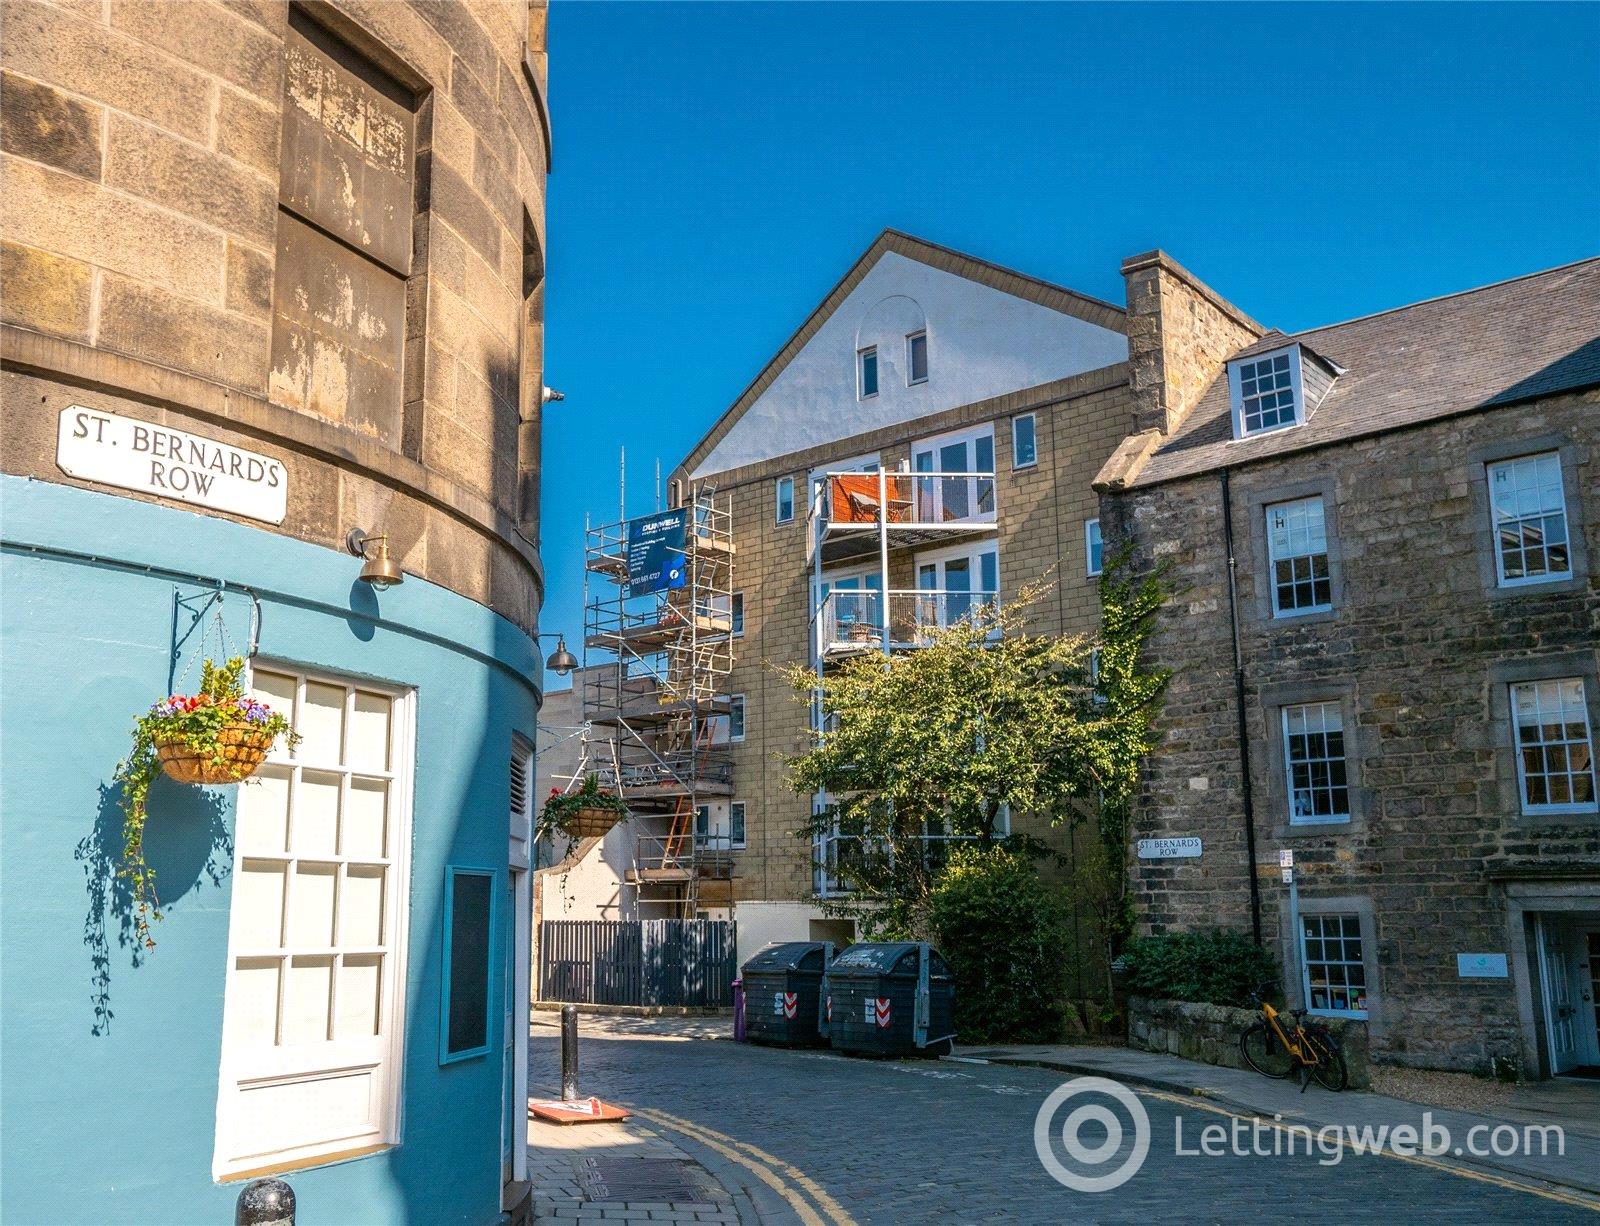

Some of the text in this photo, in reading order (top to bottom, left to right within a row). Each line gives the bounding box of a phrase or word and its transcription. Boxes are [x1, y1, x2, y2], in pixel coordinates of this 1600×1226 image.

[73, 412, 279, 488] ST. BERNARD'S
[150, 460, 215, 497] ROW
[1496, 471, 1507, 482] H
[1275, 518, 1285, 529] H
[1140, 839, 1199, 849] ST. BERNARD'S
[1159, 848, 1179, 857] ROW
